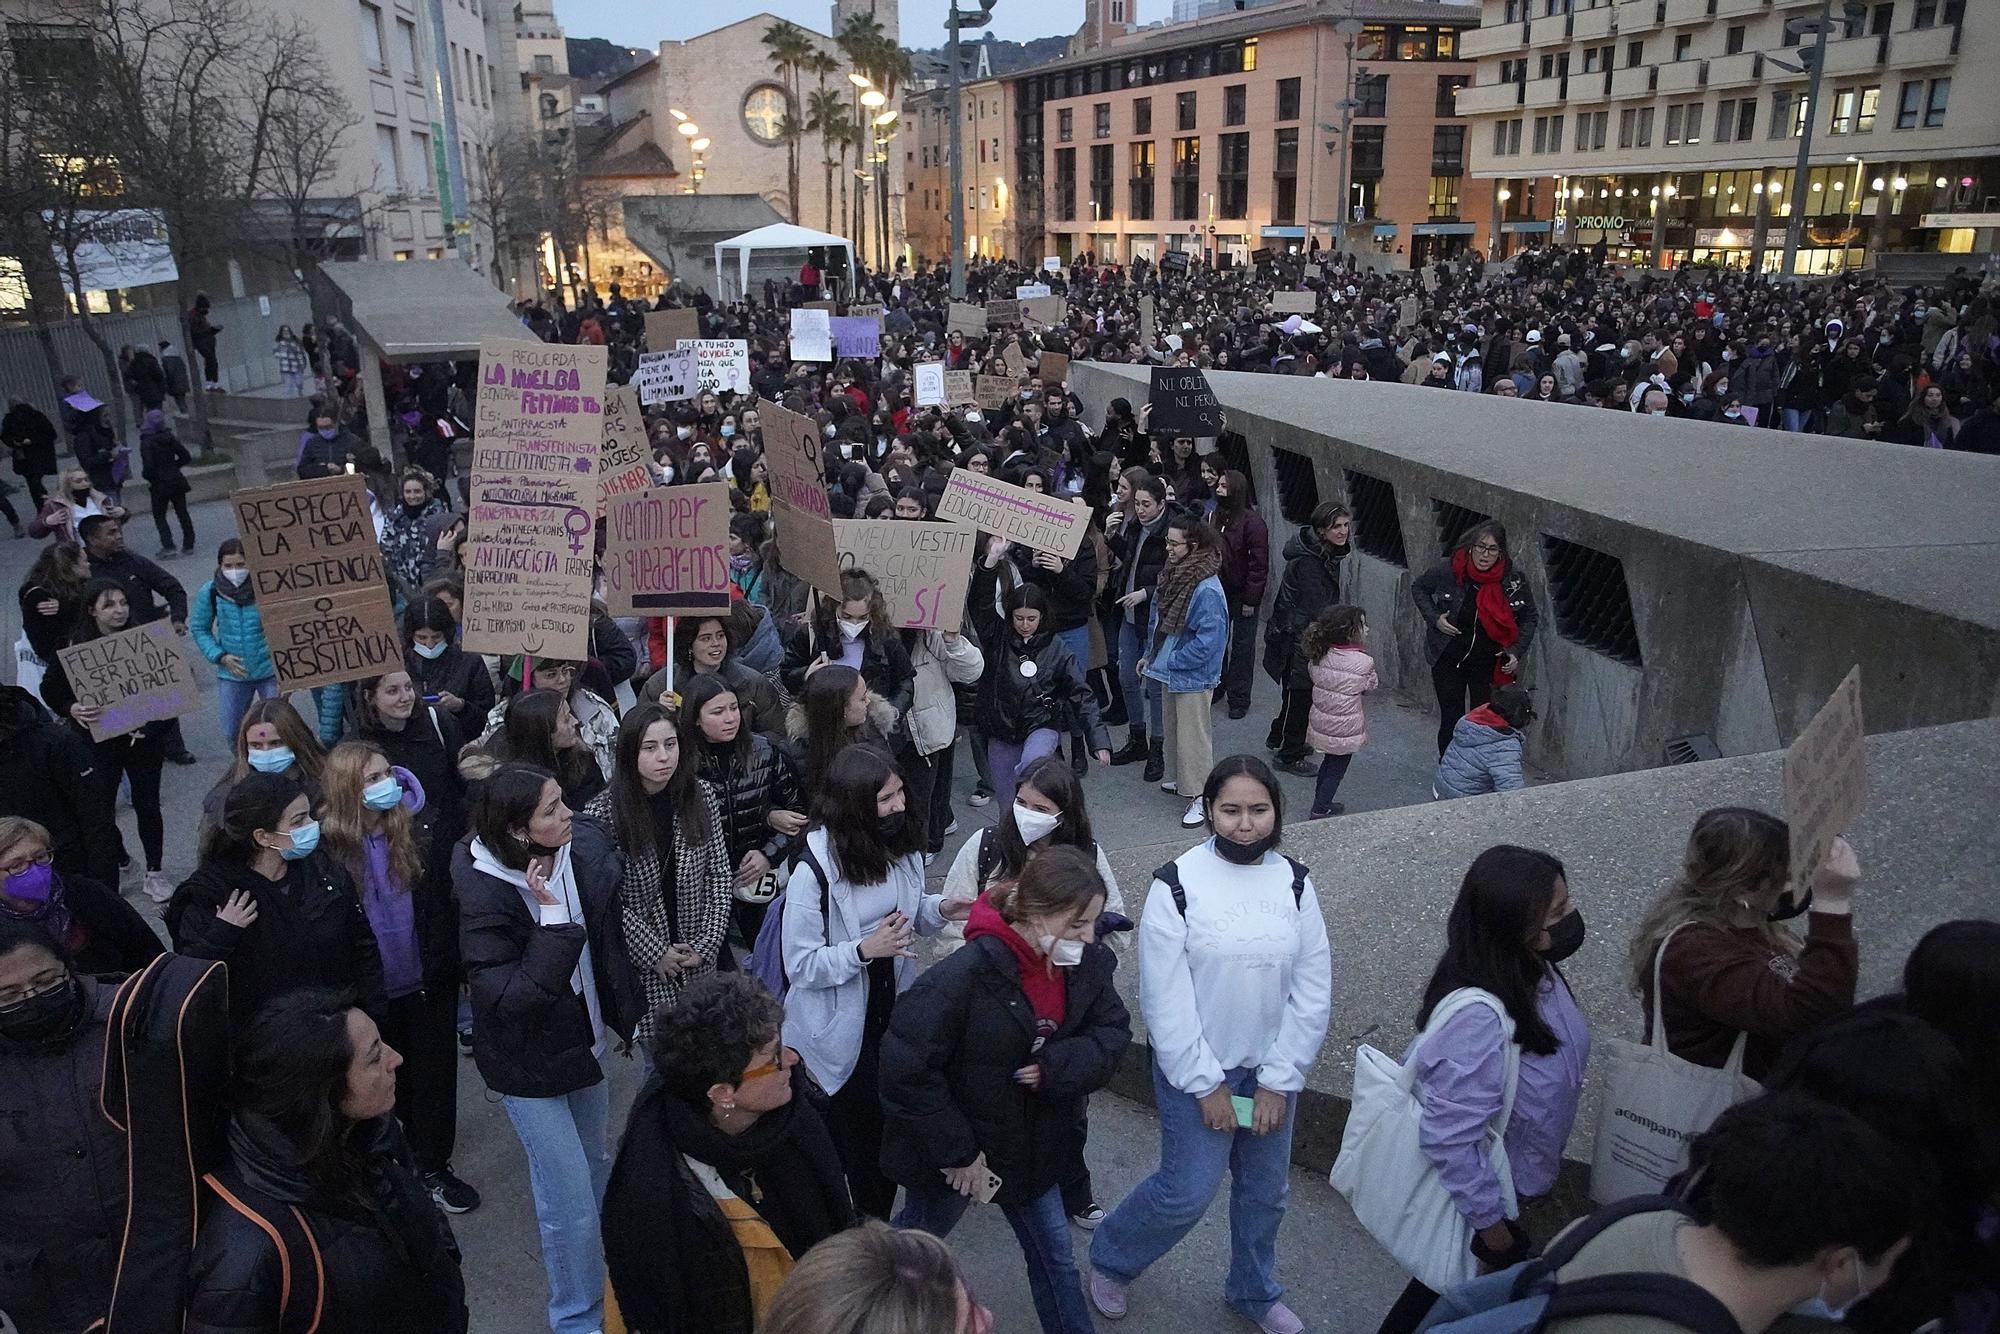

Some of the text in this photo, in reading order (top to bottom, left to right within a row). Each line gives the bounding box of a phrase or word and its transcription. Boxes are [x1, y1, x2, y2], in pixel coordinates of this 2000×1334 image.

[1556, 218, 1564, 230] P
[705, 341, 715, 350] TU
[716, 341, 735, 350] HIJO
[733, 350, 745, 359] NO
[641, 363, 670, 375] TIENE UN
[718, 359, 735, 369] QUE
[484, 363, 580, 391] LA HUELGA
[641, 374, 674, 388] ORGASMO
[1159, 377, 1175, 391] NI
[479, 387, 520, 401] GENERAL
[643, 384, 685, 401] LIMPIANDO
[1175, 395, 1191, 408] NI
[601, 439, 618, 452] NO
[238, 491, 364, 534] RESPECTA
[669, 496, 709, 538] per
[943, 492, 1068, 553] EDUQUEU ELS FILLS
[257, 520, 365, 556] LA MEVA
[853, 526, 896, 551] MEU
[910, 529, 970, 553] VESTIT
[474, 546, 558, 574] ANTIFASCISTA
[257, 554, 384, 595] EXISTÈNCIA
[472, 600, 482, 614] 8
[289, 616, 364, 646] ESPERA
[64, 641, 125, 674] FELIZ
[123, 632, 156, 654] VA
[74, 647, 180, 693] A SER EL DIA
[81, 664, 180, 707] QUE NO FALTE
